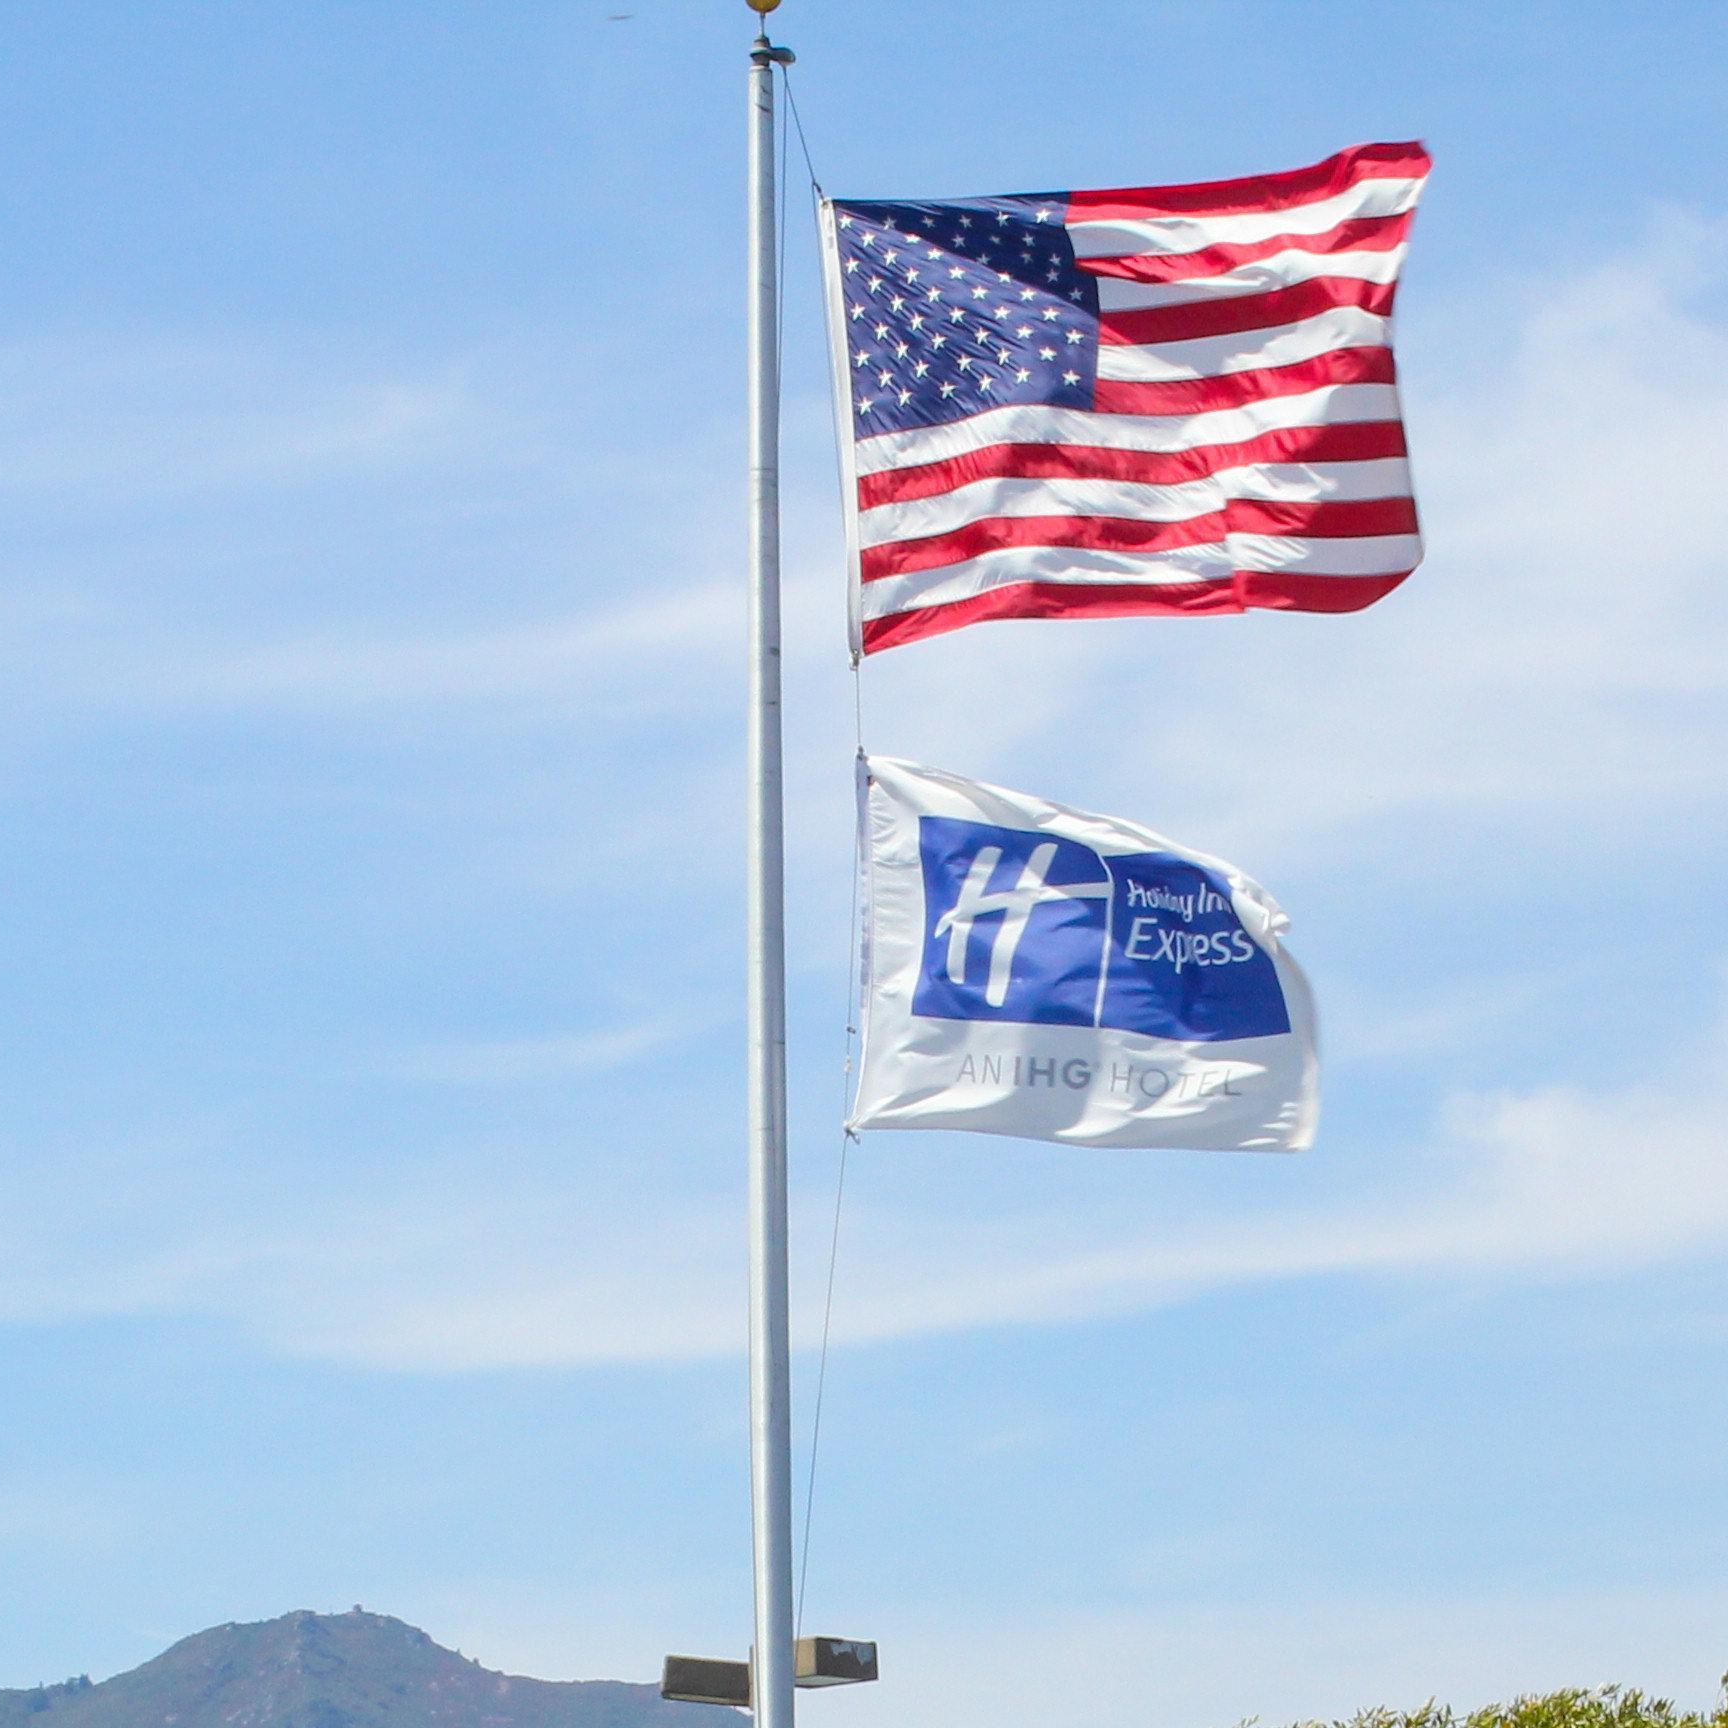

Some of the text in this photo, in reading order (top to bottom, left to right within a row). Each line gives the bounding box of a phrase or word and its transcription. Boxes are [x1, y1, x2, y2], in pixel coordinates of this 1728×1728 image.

[955, 1053, 1243, 1099] AN IHG HOTEL
